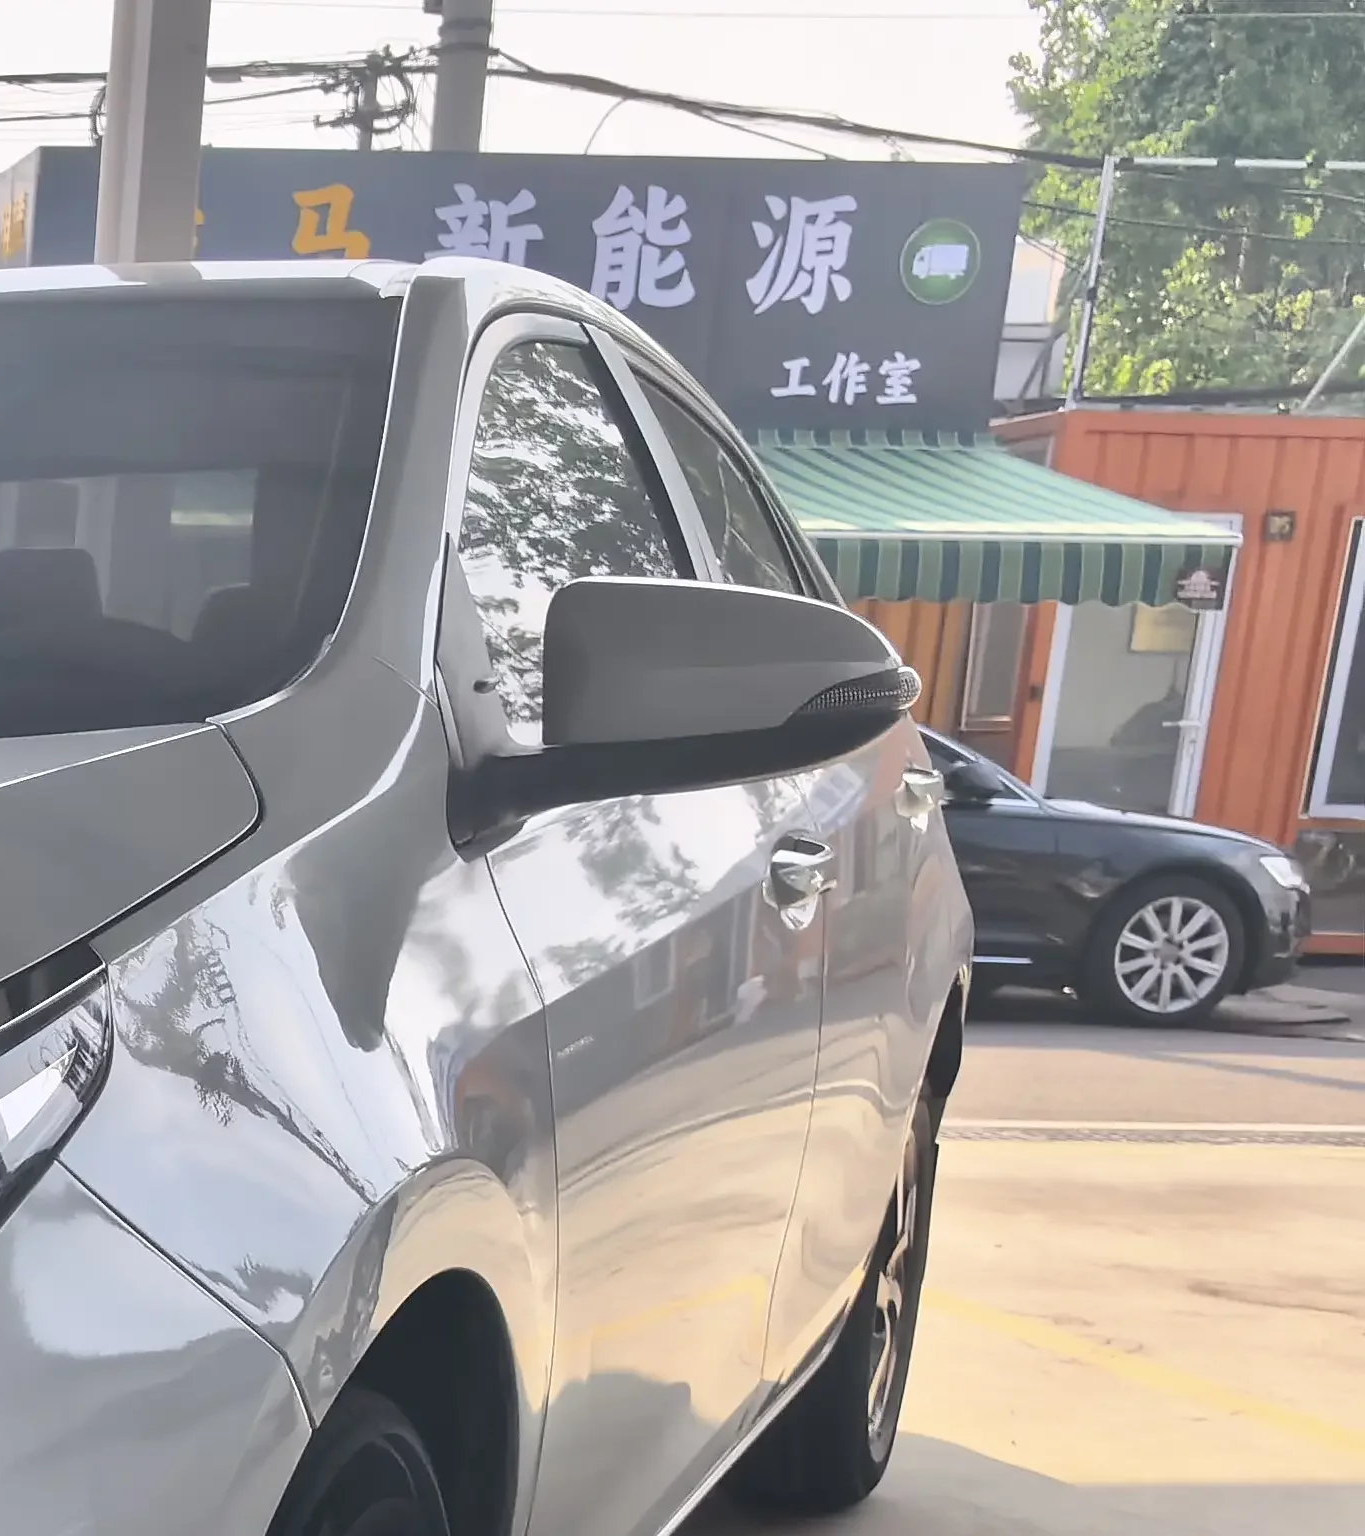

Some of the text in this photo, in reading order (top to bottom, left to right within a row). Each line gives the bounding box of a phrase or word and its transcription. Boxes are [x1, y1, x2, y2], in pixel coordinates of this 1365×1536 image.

[195, 184, 857, 315] 马新能源
[770, 352, 921, 405] 工作室
